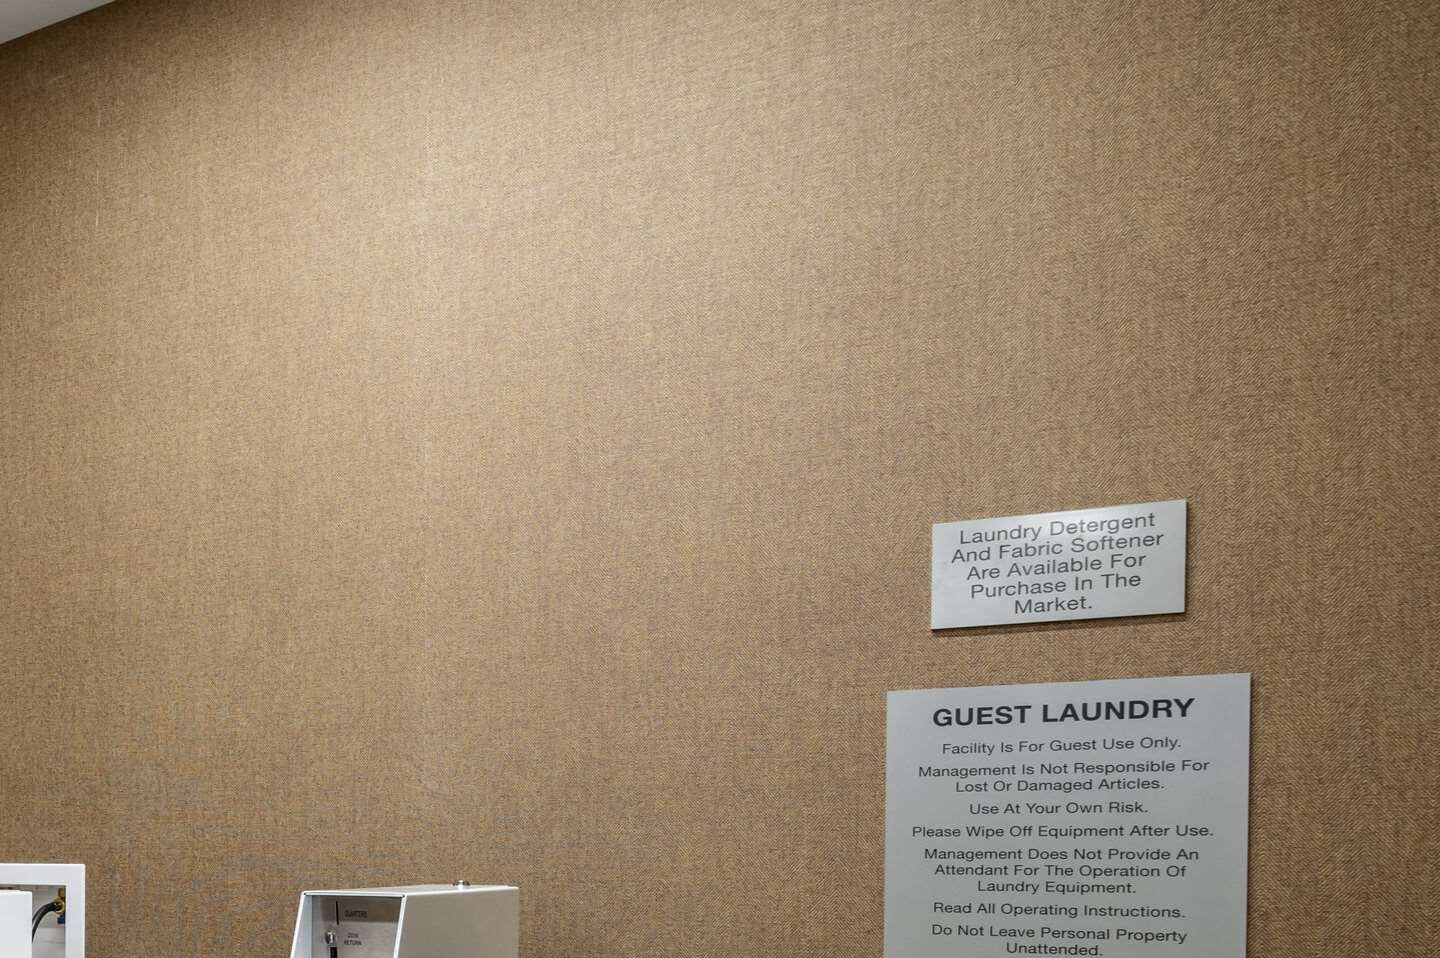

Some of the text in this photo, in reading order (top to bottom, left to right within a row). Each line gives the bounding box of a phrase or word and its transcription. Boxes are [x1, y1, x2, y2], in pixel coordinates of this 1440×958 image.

[960, 513, 1156, 544] Laundry Detergent
[951, 532, 1164, 564] And Fabric Softener
[967, 553, 1147, 581] Are Available For
[971, 573, 1141, 599] Purchase In The
[1014, 596, 1092, 614] Market.
[932, 698, 1196, 727] GUEST LAUNDRY
[942, 736, 1182, 756] Facility Is For Guest Use Only.
[918, 759, 1210, 779] Management Is Not Responsible For
[956, 778, 1165, 794] Lost Or Damaged Articles.
[969, 801, 1148, 814] Use At Your Own Risk.
[912, 824, 1214, 839] Please Wipe Off Equipment After Use.
[924, 848, 1199, 863] Management Does Not Provide An
[934, 864, 1188, 879] Attendant For The Operation Of
[978, 881, 1136, 896] Laundry Equipment.
[933, 902, 1186, 918] Read All Operating Instructions.
[932, 924, 1188, 944] Do Not Leave Personal Property
[1006, 942, 1103, 956] Unattended.
